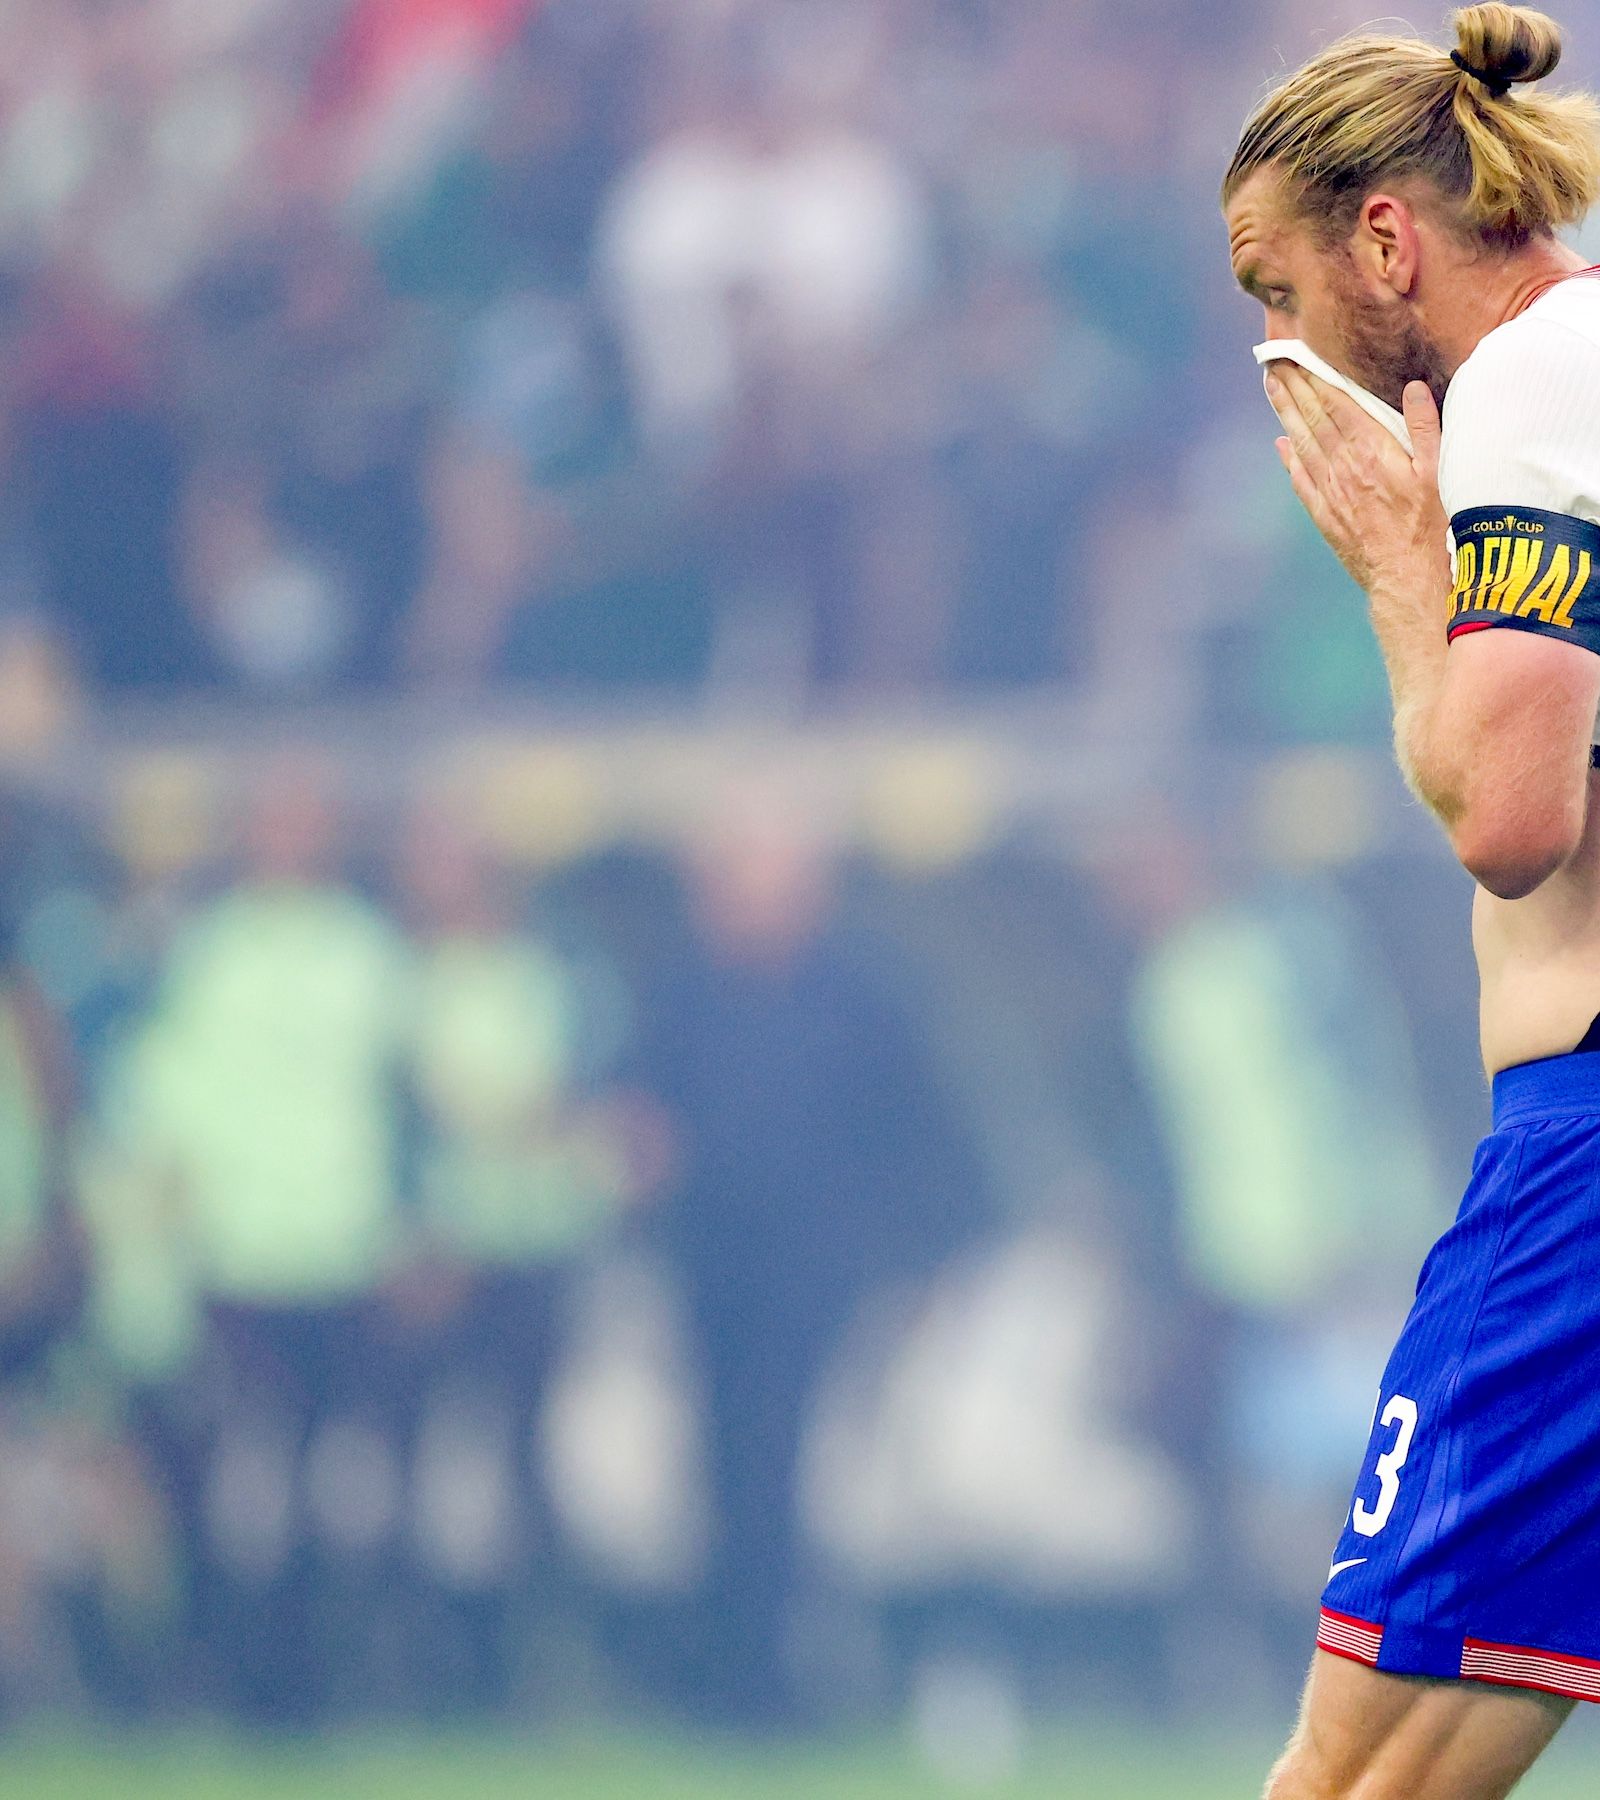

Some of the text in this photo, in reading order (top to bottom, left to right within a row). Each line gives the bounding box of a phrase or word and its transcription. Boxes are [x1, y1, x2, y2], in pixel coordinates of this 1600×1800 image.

[1472, 521, 1505, 533] GOLD
[1516, 521, 1545, 534] CUP
[1473, 536, 1592, 629] FINAL
[1343, 1387, 1419, 1538] 3
